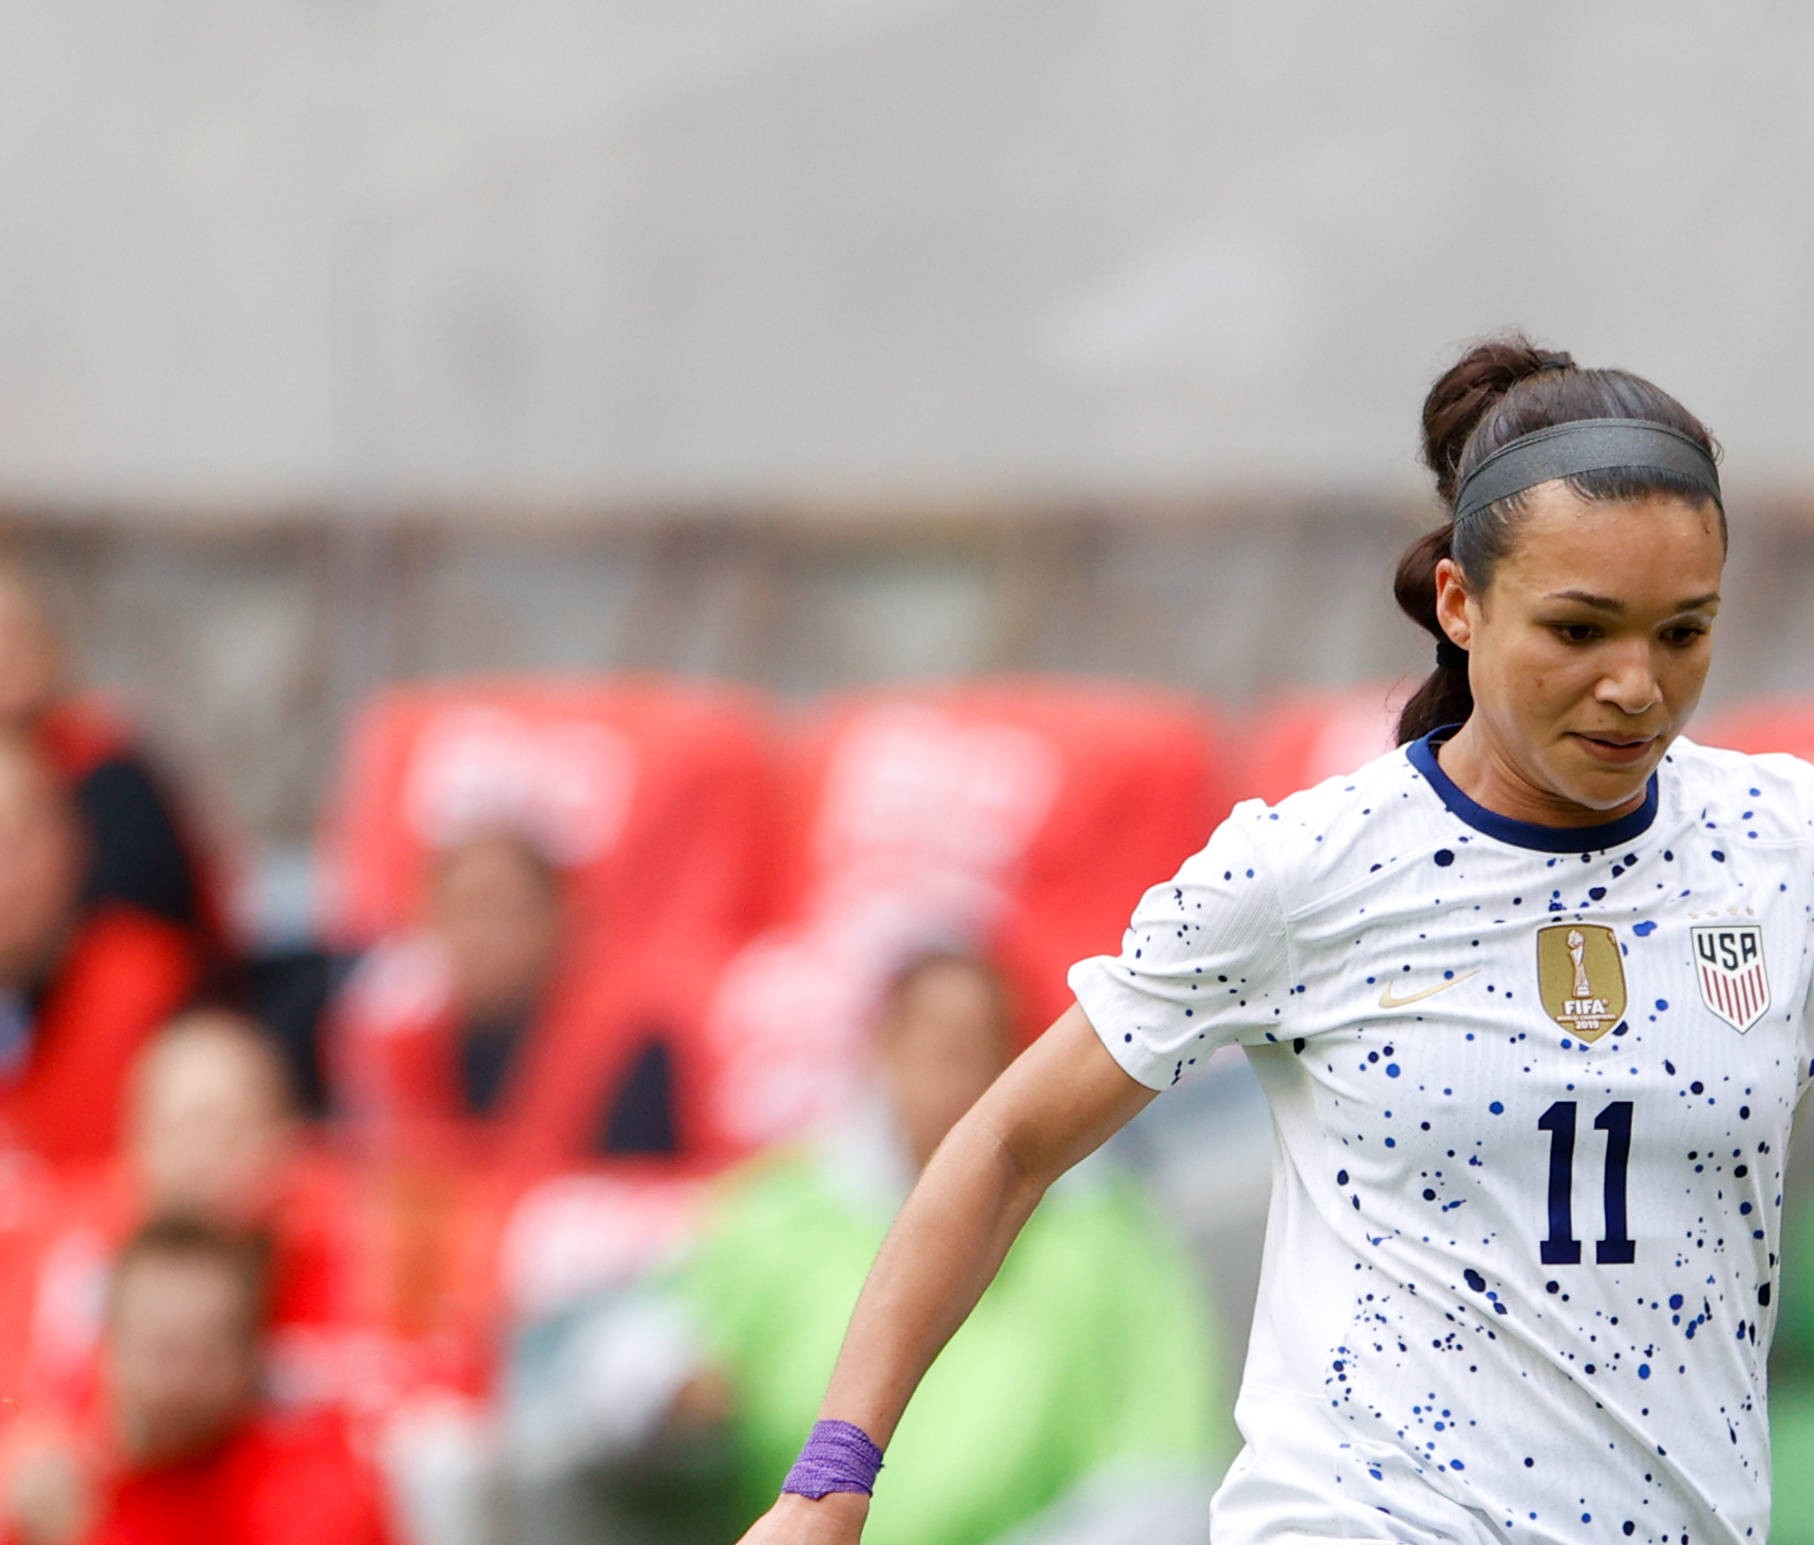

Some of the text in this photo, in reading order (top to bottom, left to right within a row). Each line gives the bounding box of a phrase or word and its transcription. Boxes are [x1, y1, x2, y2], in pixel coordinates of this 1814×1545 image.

[1697, 933, 1757, 971] USA
[1564, 1000, 1605, 1015] FIFA
[1575, 1021, 1599, 1030] 2019
[1538, 1101, 1636, 1265] 11
